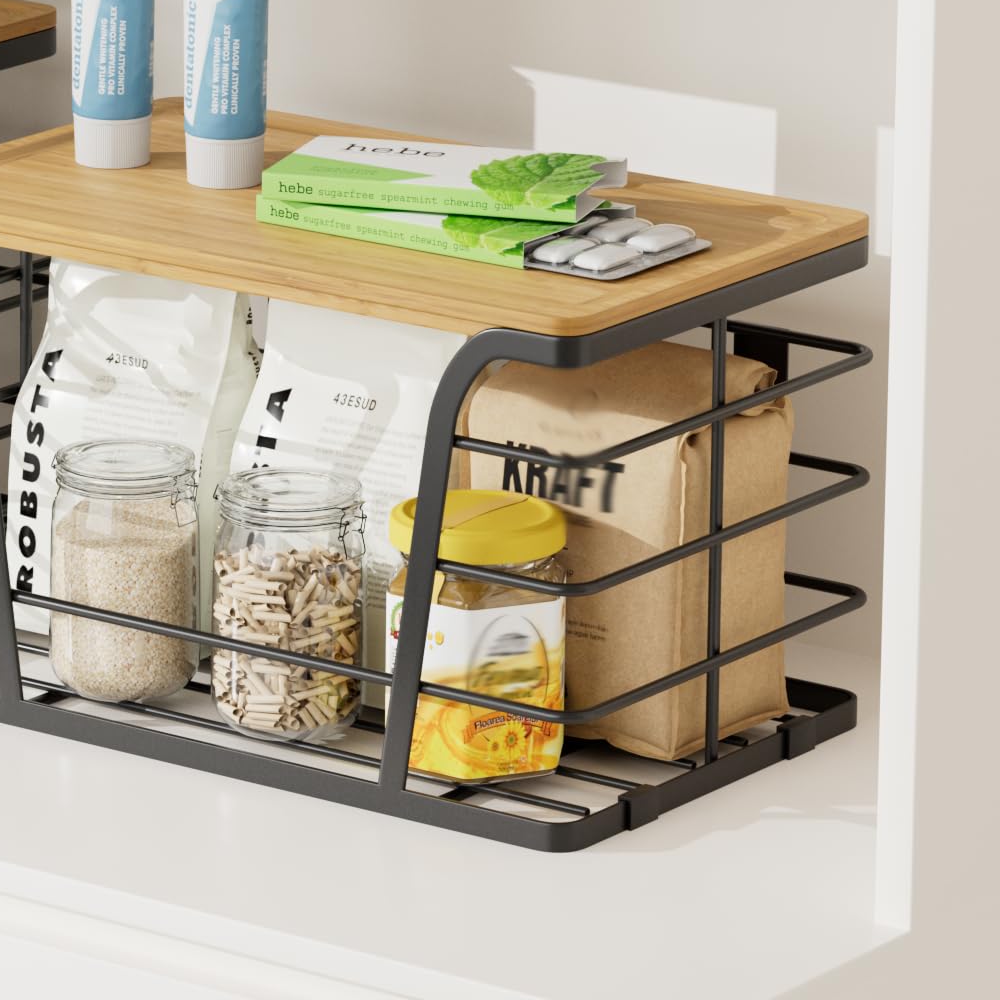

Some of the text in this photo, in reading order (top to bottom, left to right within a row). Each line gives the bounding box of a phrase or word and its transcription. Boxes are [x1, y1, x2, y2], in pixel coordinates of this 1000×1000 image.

[119, 20, 127, 54] PROVEN
[223, 24, 231, 60] COMPLEX
[232, 38, 240, 72] PROVEN
[345, 143, 446, 158] hebe
[278, 181, 514, 211] hebe sugarfree spearmint chewing gum
[270, 205, 448, 250] hebe sugarfree spearmint chewing
[105, 352, 149, 370] 43ESUD
[333, 392, 377, 411] 43ESUD
[16, 349, 64, 593] ROBUSTA
[502, 440, 625, 513] KRAFT
